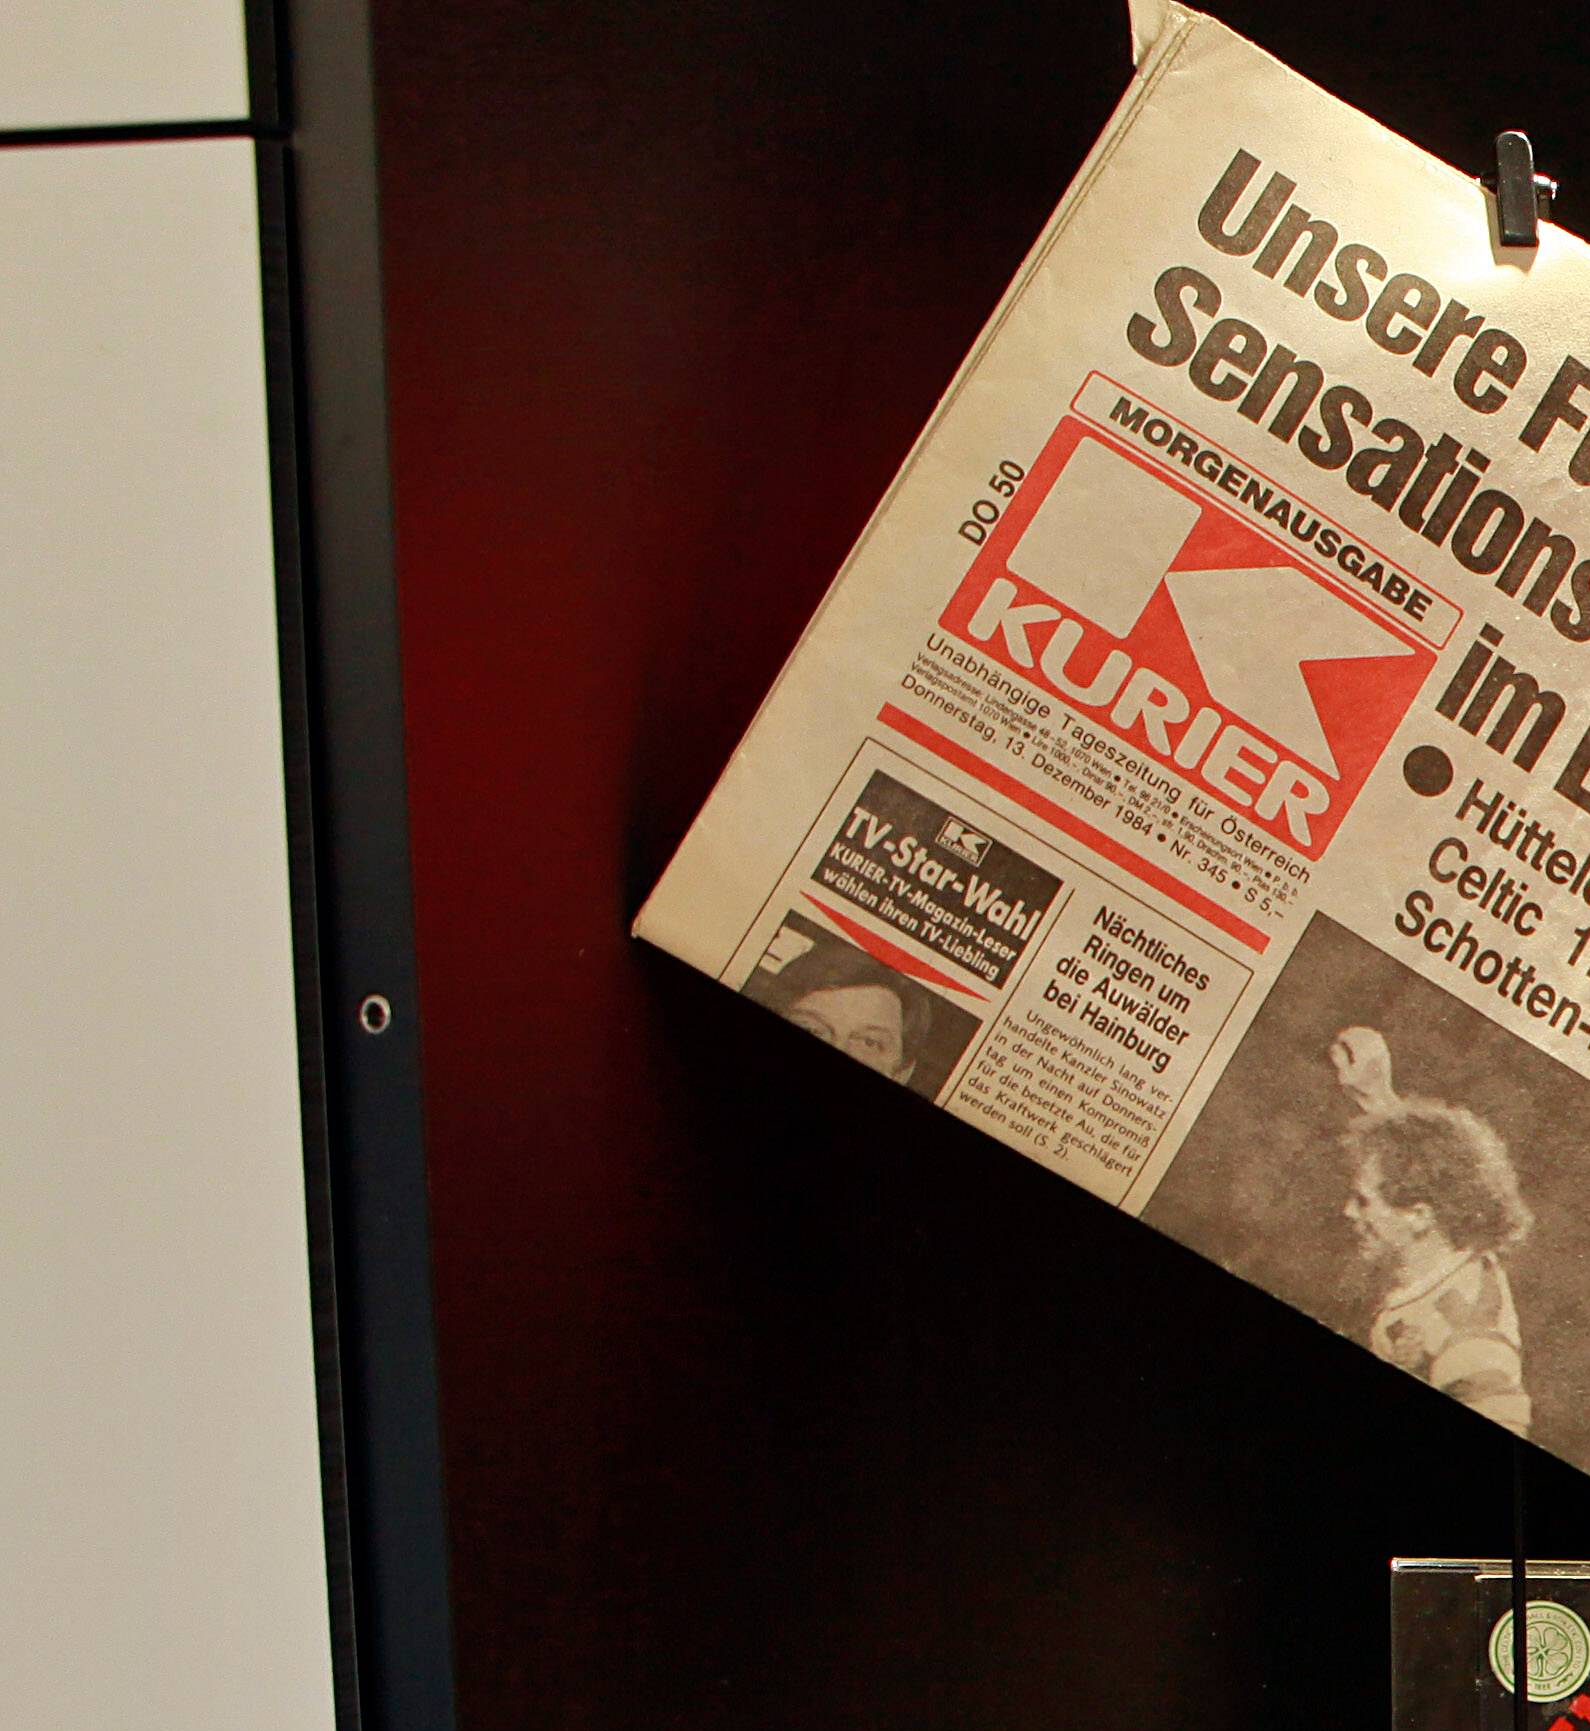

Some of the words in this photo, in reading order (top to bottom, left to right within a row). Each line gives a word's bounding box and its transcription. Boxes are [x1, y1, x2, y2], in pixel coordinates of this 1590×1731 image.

[1196, 147, 1527, 414] Unsere
[957, 499, 999, 546] DO
[987, 459, 1025, 498] 50
[1108, 395, 1433, 622] MORGENAUSGABE
[957, 577, 1340, 847] KURIER
[1434, 621, 1566, 773] im
[900, 673, 996, 743] Donnerstag,
[1004, 736, 1025, 759] 13.
[1030, 752, 1111, 809] Dezember
[1114, 804, 1153, 835] 1984
[1169, 839, 1191, 863] Nr.
[1196, 856, 1228, 883] 345
[925, 632, 1050, 718] Unabhängige
[1061, 712, 1182, 804] Tageszeitung
[1187, 795, 1214, 820] für
[1220, 814, 1310, 884] Österreich
[823, 867, 878, 907] wählen
[878, 896, 918, 931] ihren
[919, 920, 1000, 981] TV-Liebling
[829, 841, 1017, 961] KURIER-TV-Magazin-Leser
[845, 805, 1041, 940] TV-Star-Wahl
[1428, 836, 1542, 936] Celtic
[1055, 956, 1089, 985] die
[1091, 975, 1189, 1045] Auwälder
[1082, 933, 1155, 991] Ringen
[1157, 983, 1190, 1014] um
[1092, 904, 1209, 990] Nächtliches
[1042, 978, 1081, 1013] bei
[1079, 1001, 1171, 1074] Hainburg
